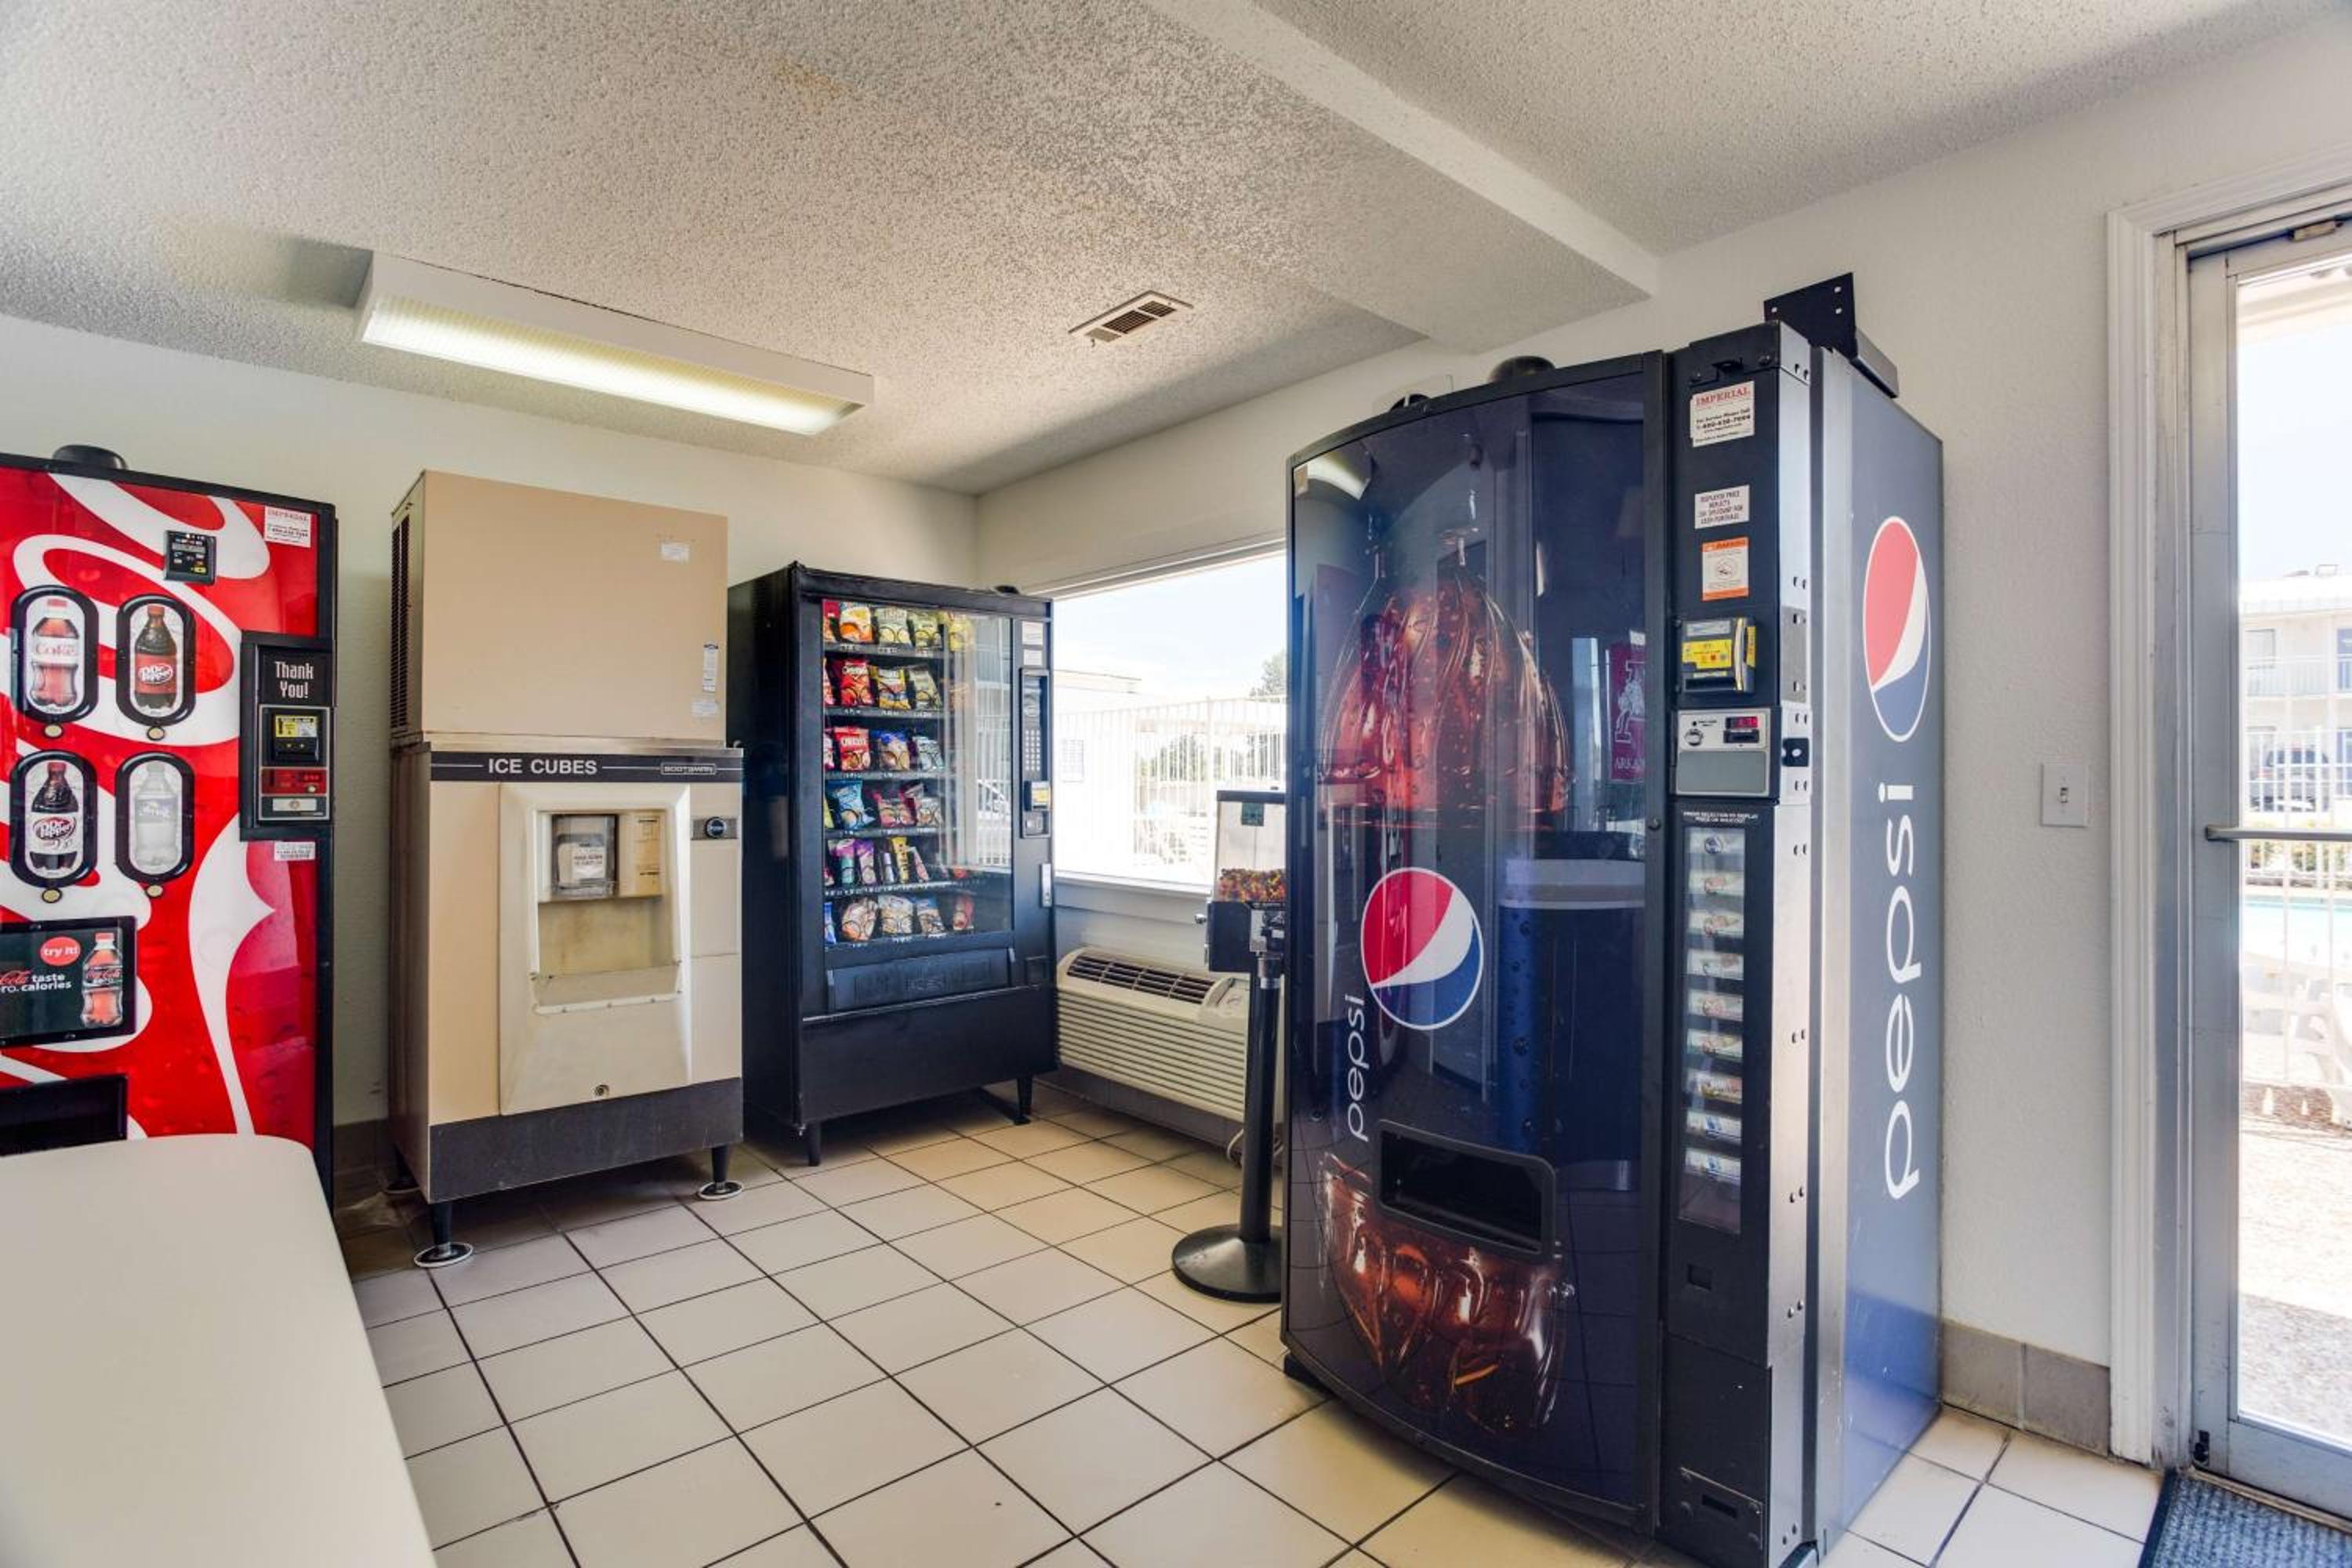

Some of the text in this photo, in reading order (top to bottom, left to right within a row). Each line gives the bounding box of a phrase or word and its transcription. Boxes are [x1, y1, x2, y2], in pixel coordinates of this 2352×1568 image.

[1696, 386, 1751, 406] IMPERIAL
[274, 661, 314, 680] Thank
[280, 680, 309, 699] You!
[488, 758, 597, 775] ICE CUBES
[44, 947, 63, 957] try
[21, 980, 72, 992] calories
[32, 974, 65, 983] taste
[1878, 781, 1922, 1200] pepsi
[1345, 993, 1370, 1142] pepsi
